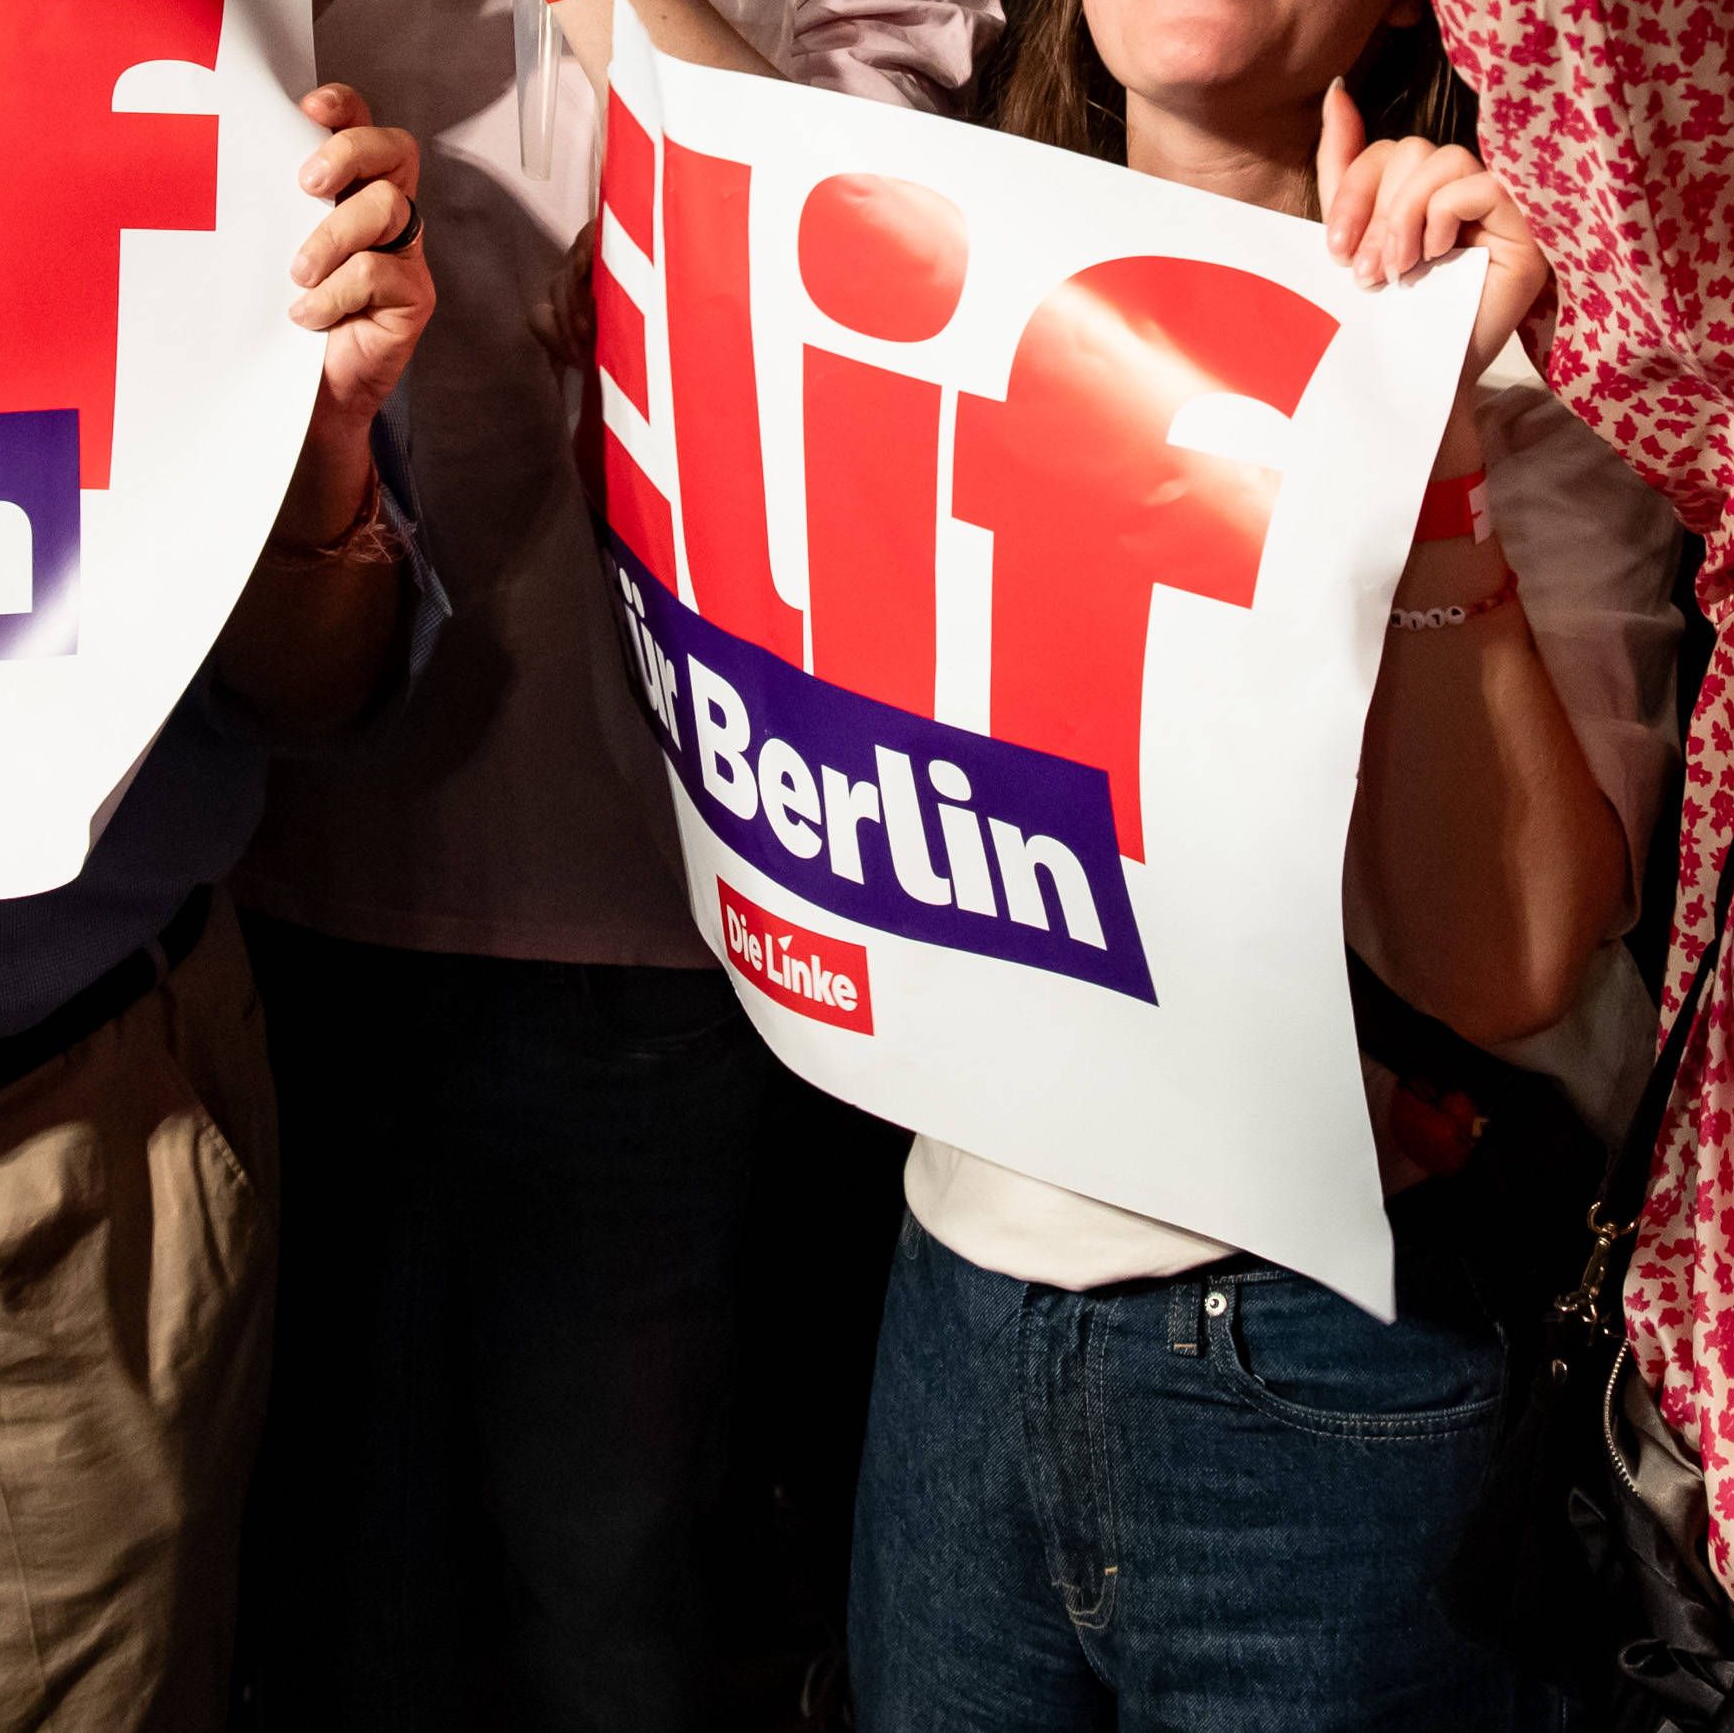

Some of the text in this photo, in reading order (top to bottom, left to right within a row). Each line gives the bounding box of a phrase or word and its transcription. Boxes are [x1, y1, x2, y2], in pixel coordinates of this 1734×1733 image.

[614, 562, 1108, 952] ür Berlin
[725, 905, 859, 1012] Die Linke
